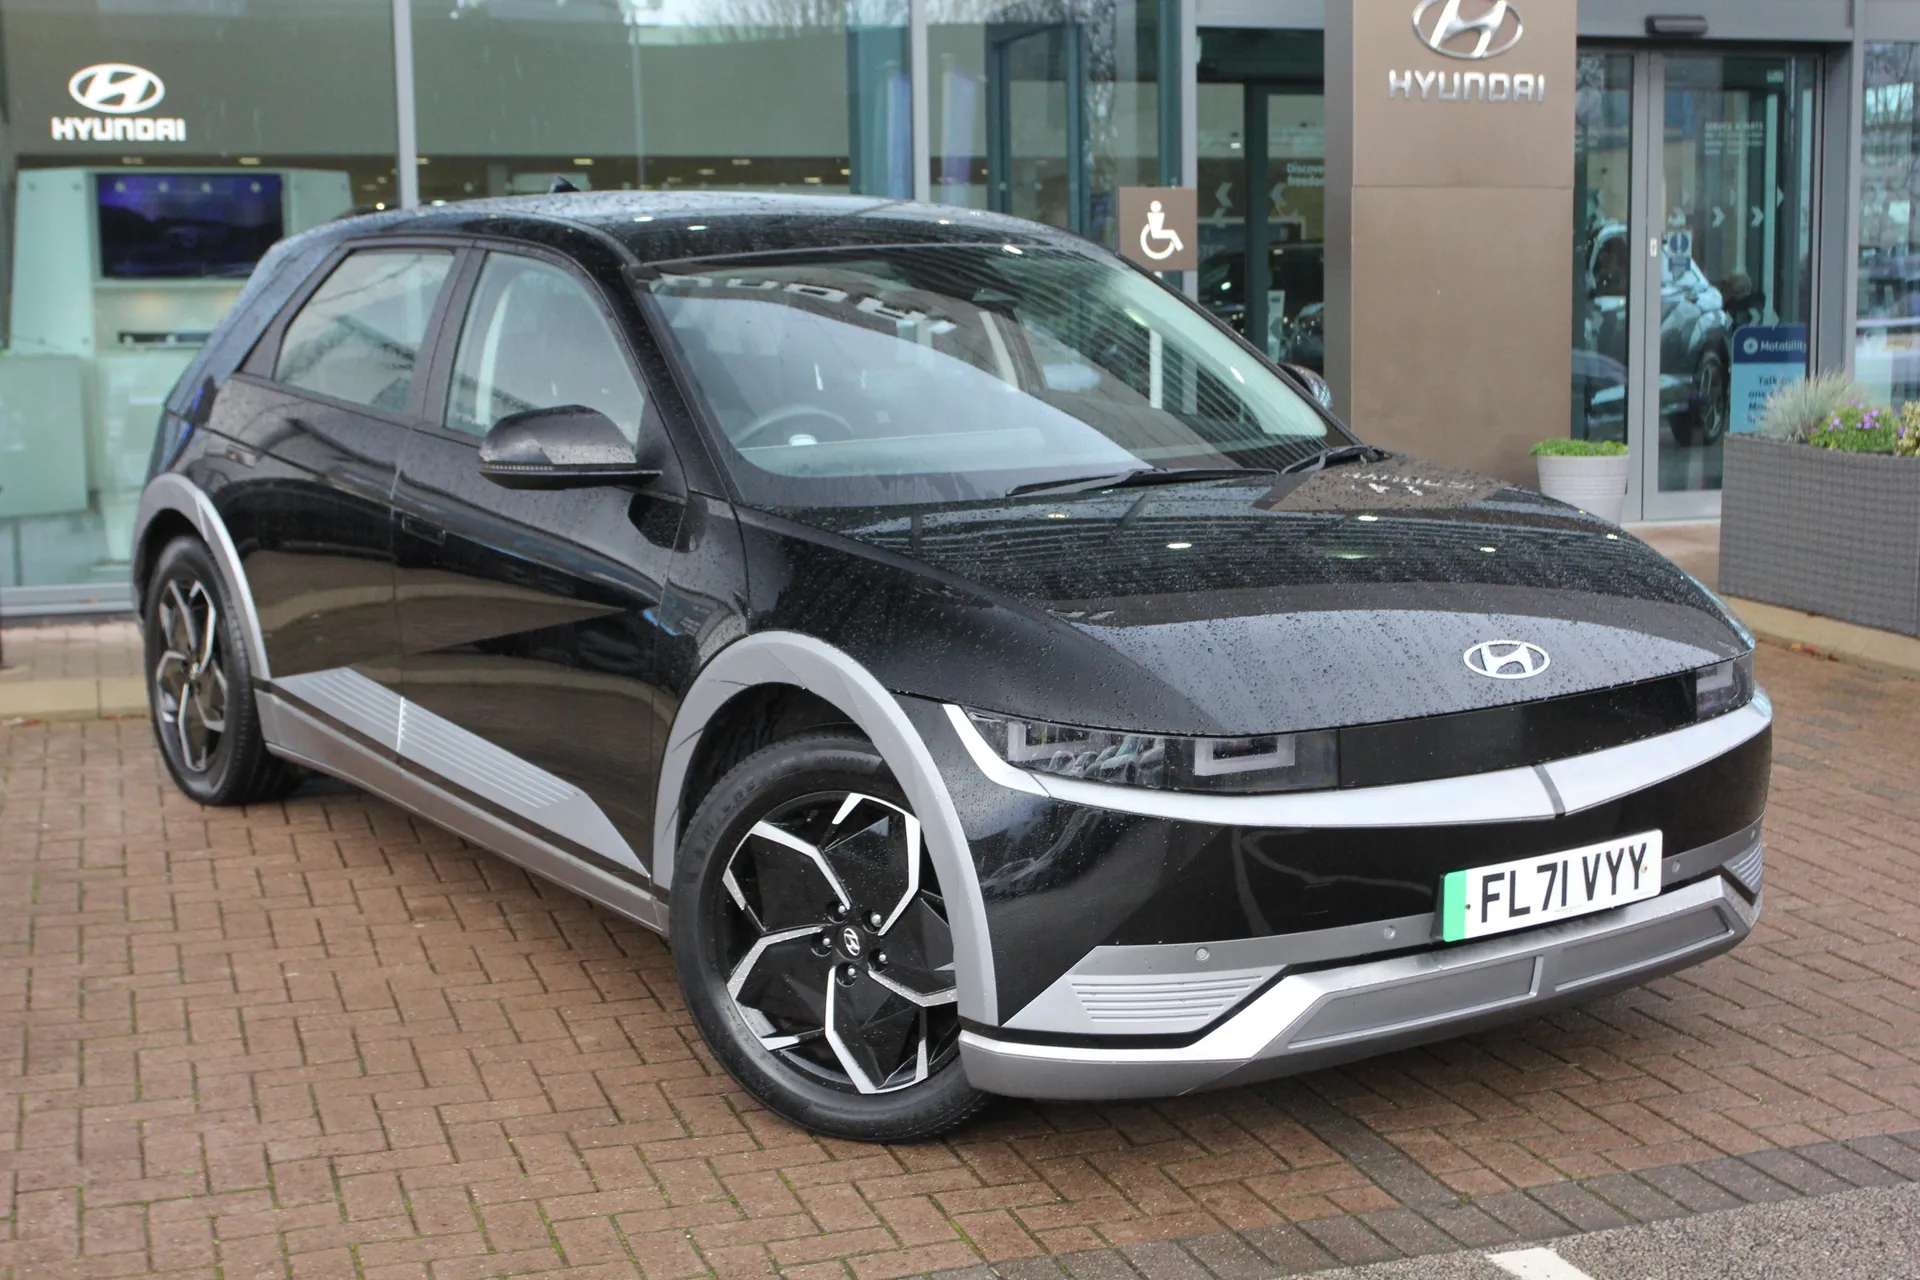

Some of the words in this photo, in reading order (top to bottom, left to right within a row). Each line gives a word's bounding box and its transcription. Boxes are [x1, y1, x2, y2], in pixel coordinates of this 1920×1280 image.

[1388, 69, 1545, 102] HYUNDAI
[51, 116, 186, 141] HYUNDAI
[1481, 860, 1569, 923] FL71
[1582, 843, 1647, 902] VYY
